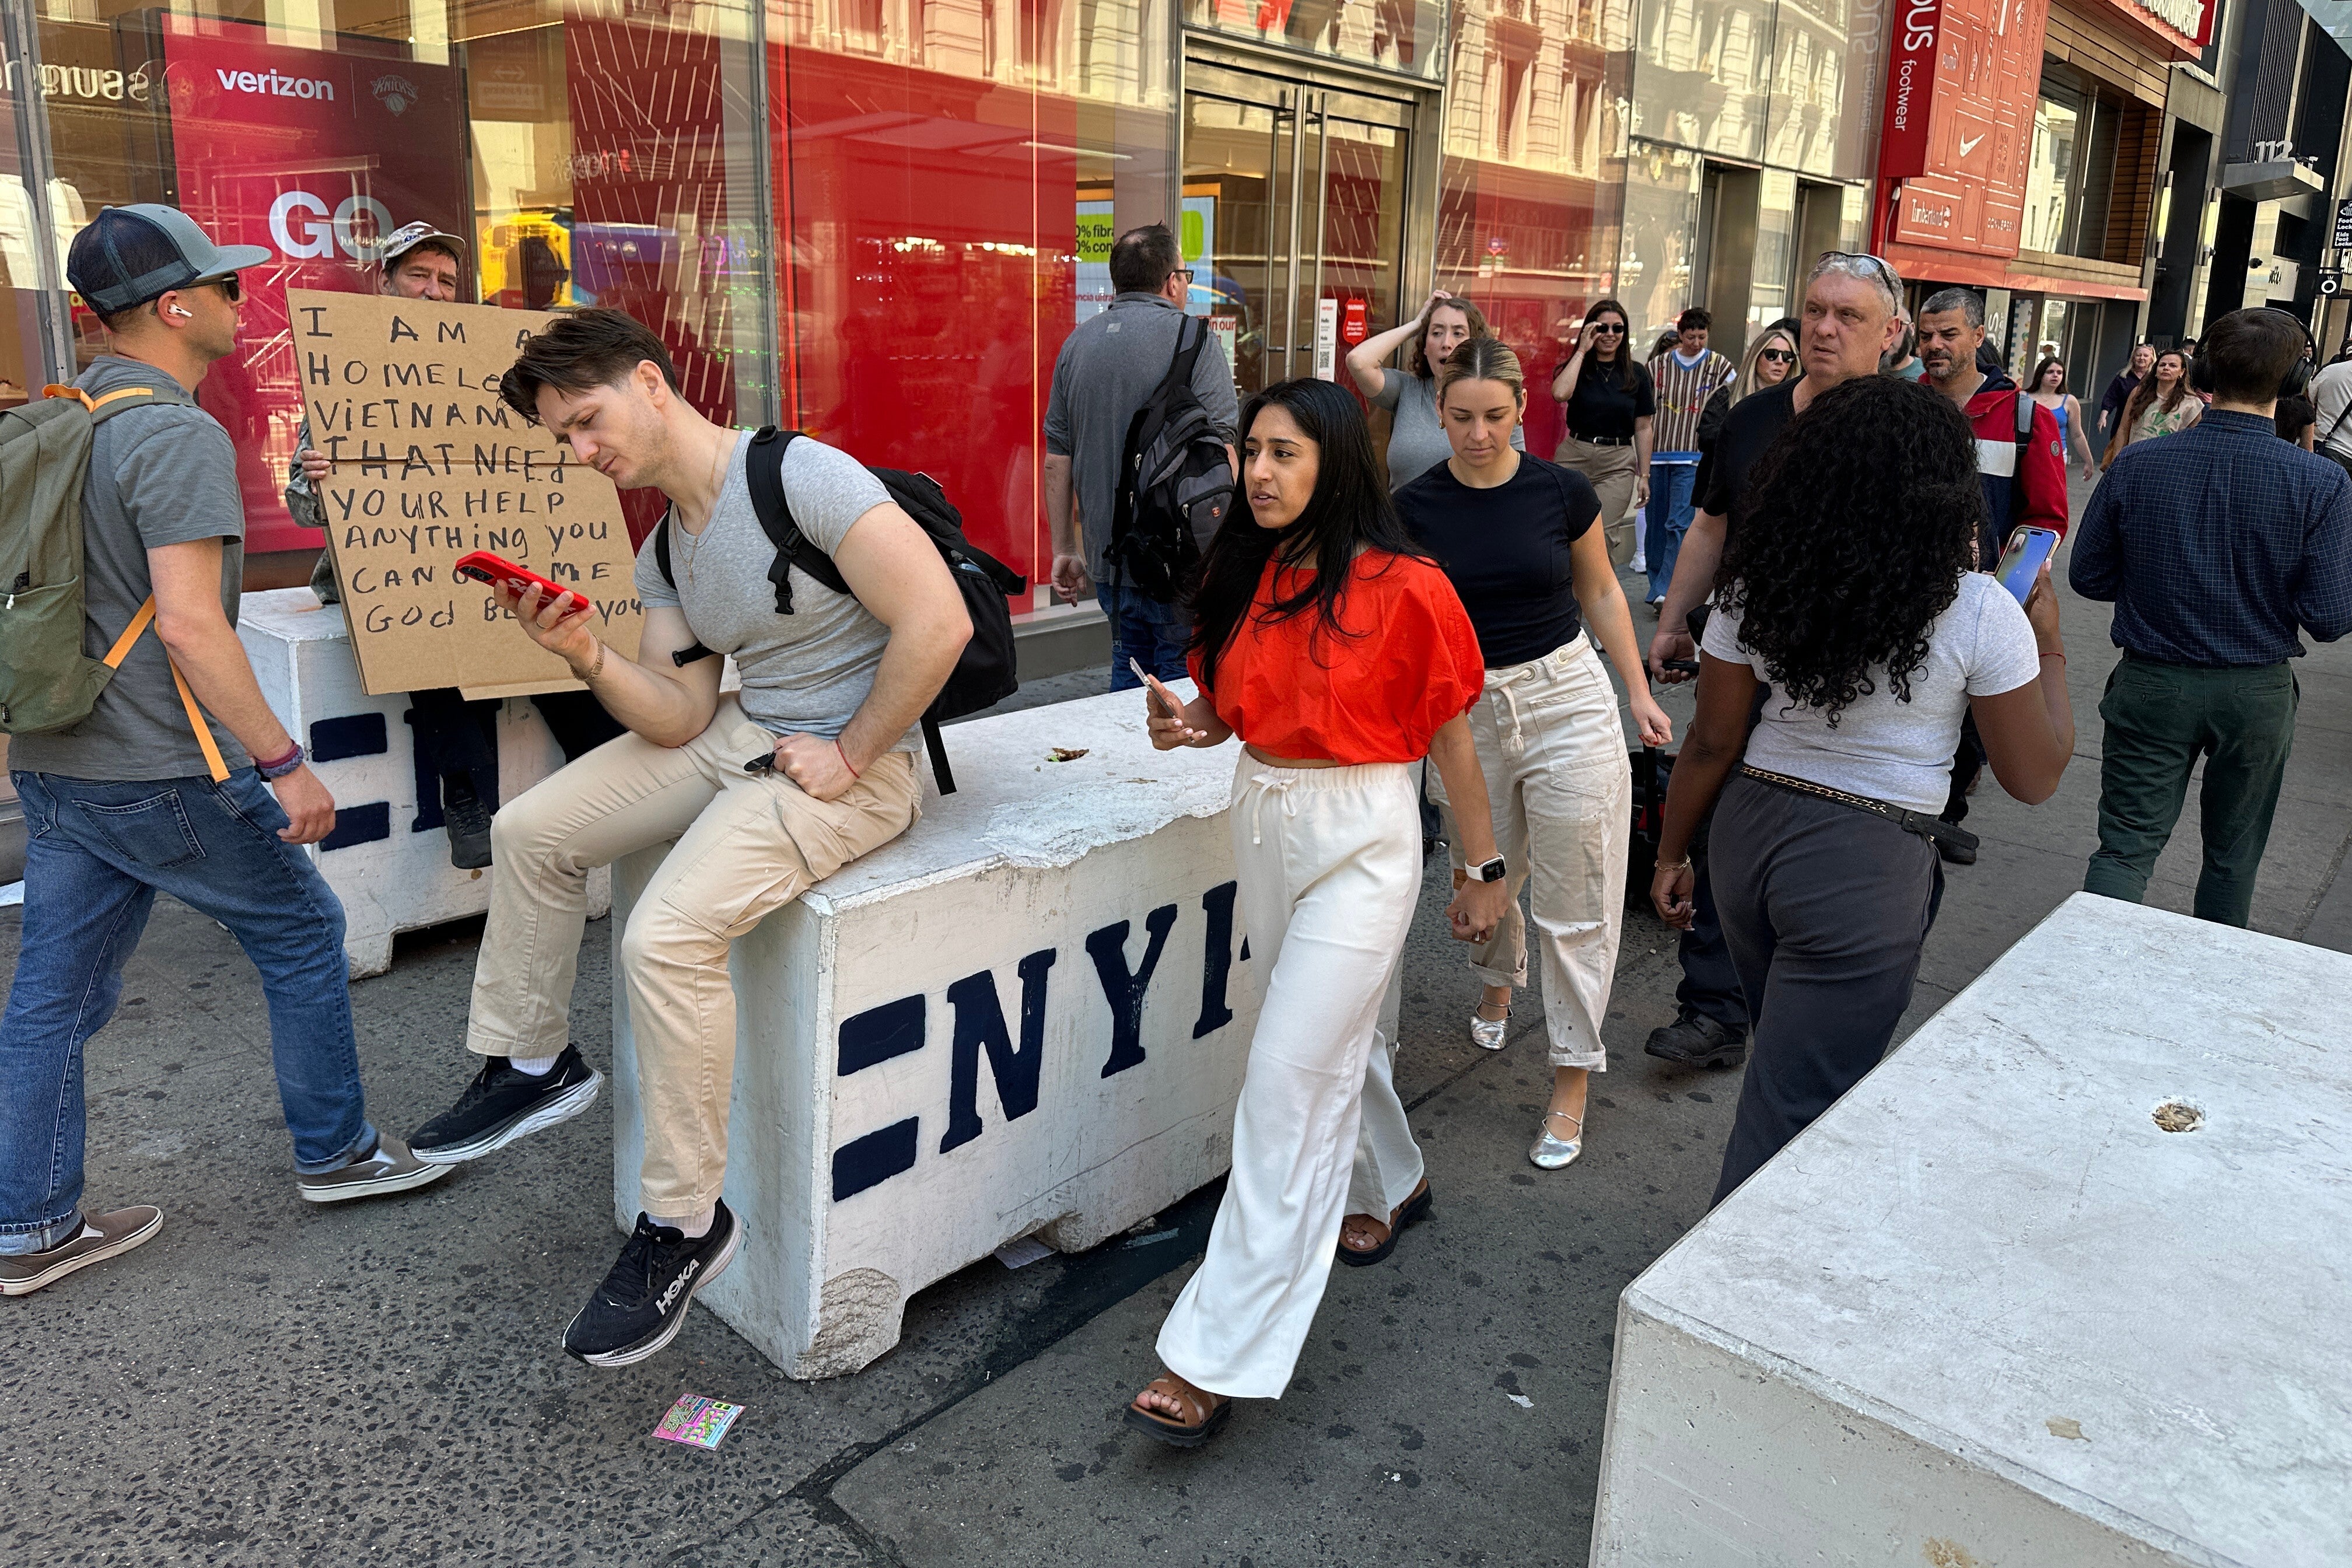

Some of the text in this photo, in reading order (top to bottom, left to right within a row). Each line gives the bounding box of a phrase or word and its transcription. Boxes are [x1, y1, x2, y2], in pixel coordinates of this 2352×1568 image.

[216, 68, 334, 101] verizon
[1895, 59, 1917, 131] footwear
[2255, 140, 2298, 163] 112
[269, 191, 394, 260] GO
[300, 307, 332, 337] I
[390, 316, 466, 343] AM
[1219, 321, 1236, 331] our
[331, 488, 565, 521] YOUR HELP
[352, 566, 436, 593] CAN
[551, 562, 611, 583] ME
[655, 1258, 700, 1316] HOKA
